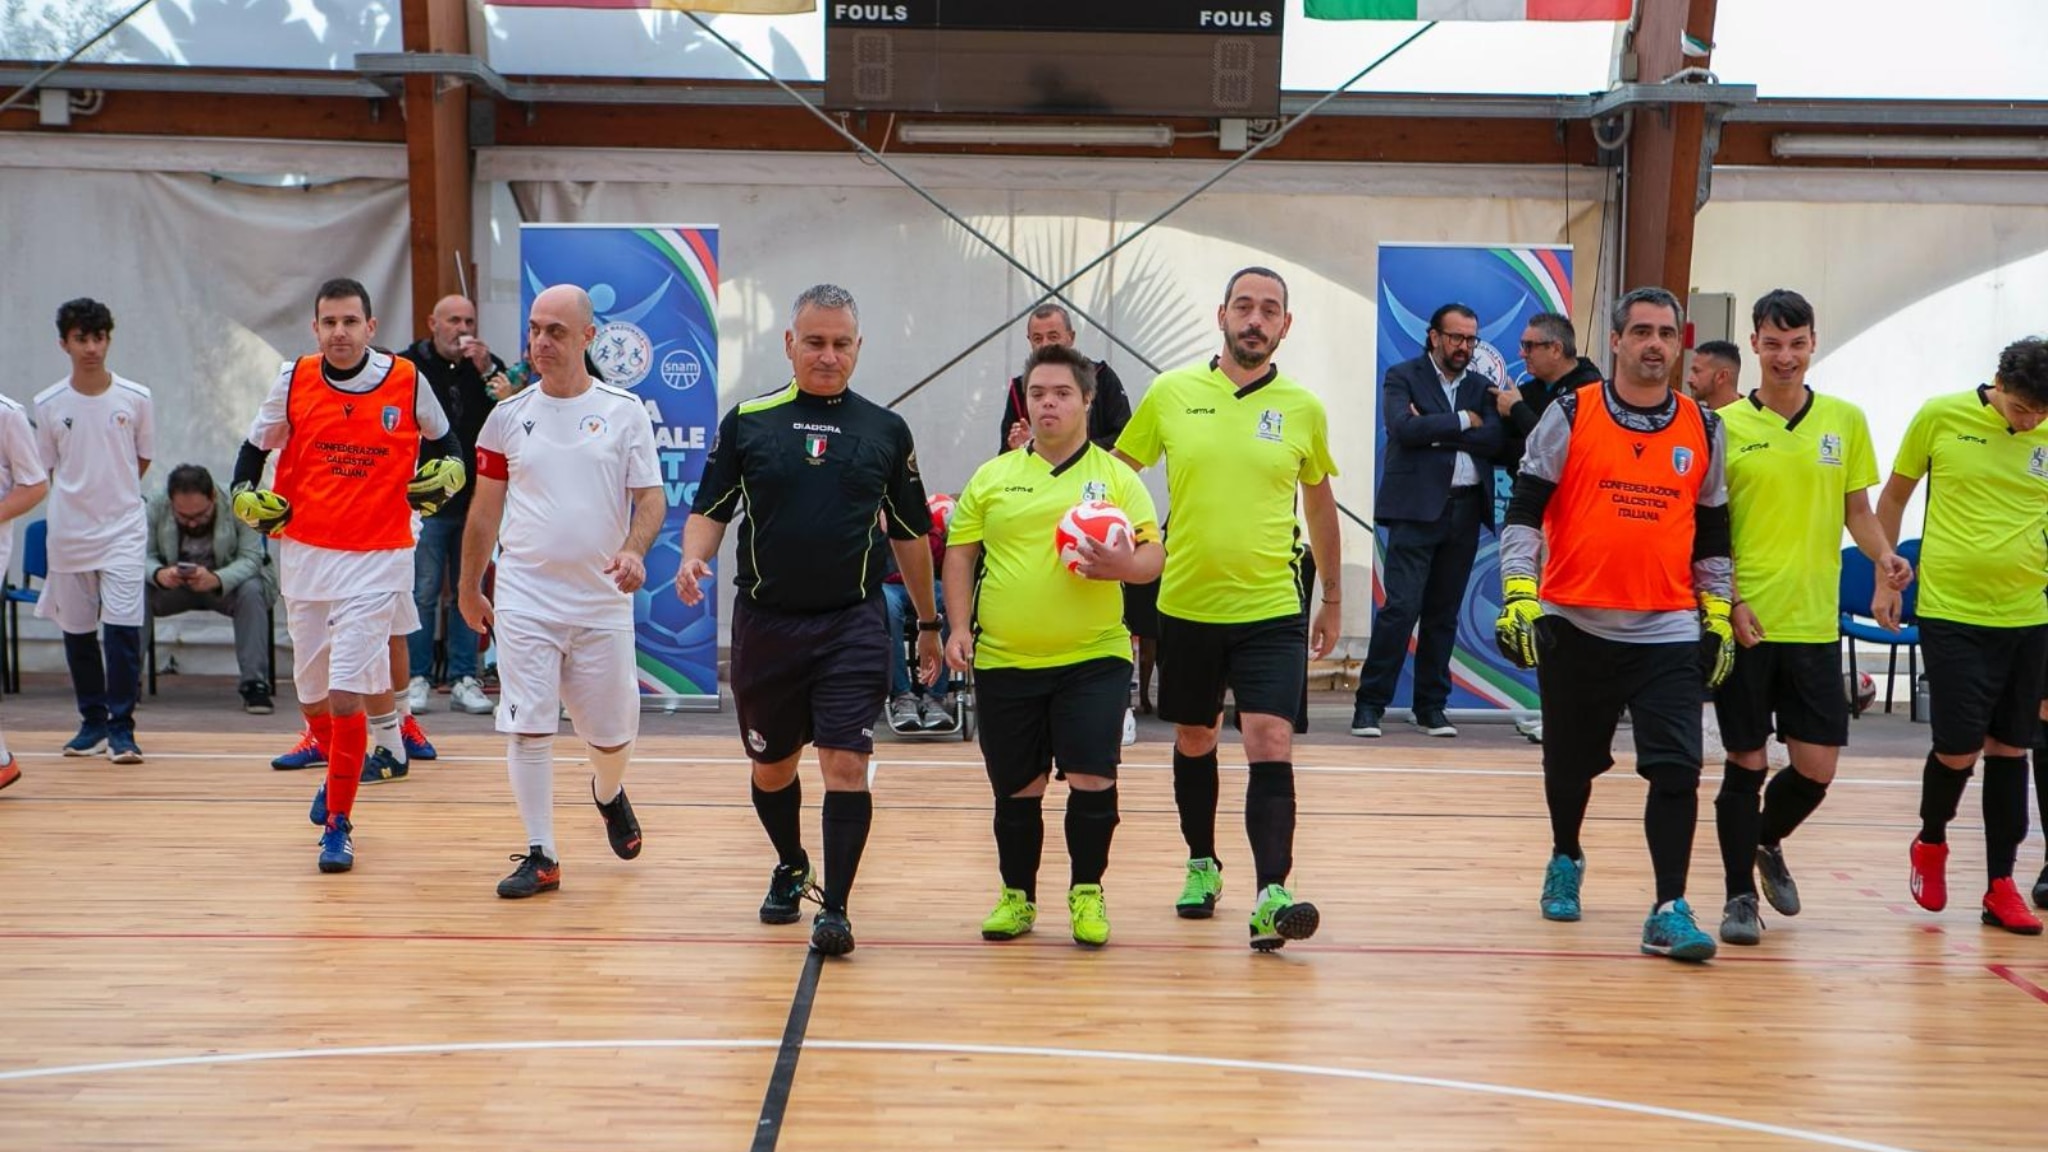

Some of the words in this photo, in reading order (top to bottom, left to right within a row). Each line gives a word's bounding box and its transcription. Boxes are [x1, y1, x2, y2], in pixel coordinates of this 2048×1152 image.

[835, 4, 908, 20] FOULS
[1200, 10, 1273, 27] FOULS
[664, 363, 698, 373] snam
[793, 422, 841, 434] DIADORA
[316, 442, 390, 456] CONFEDERAZIONE
[327, 456, 375, 467] CALCISTICA
[332, 467, 368, 478] ITALIANA
[1599, 480, 1680, 498] CONFEDERAZIONE
[1612, 494, 1668, 508] CALCISTICA
[1618, 508, 1660, 521] ITALIANA
